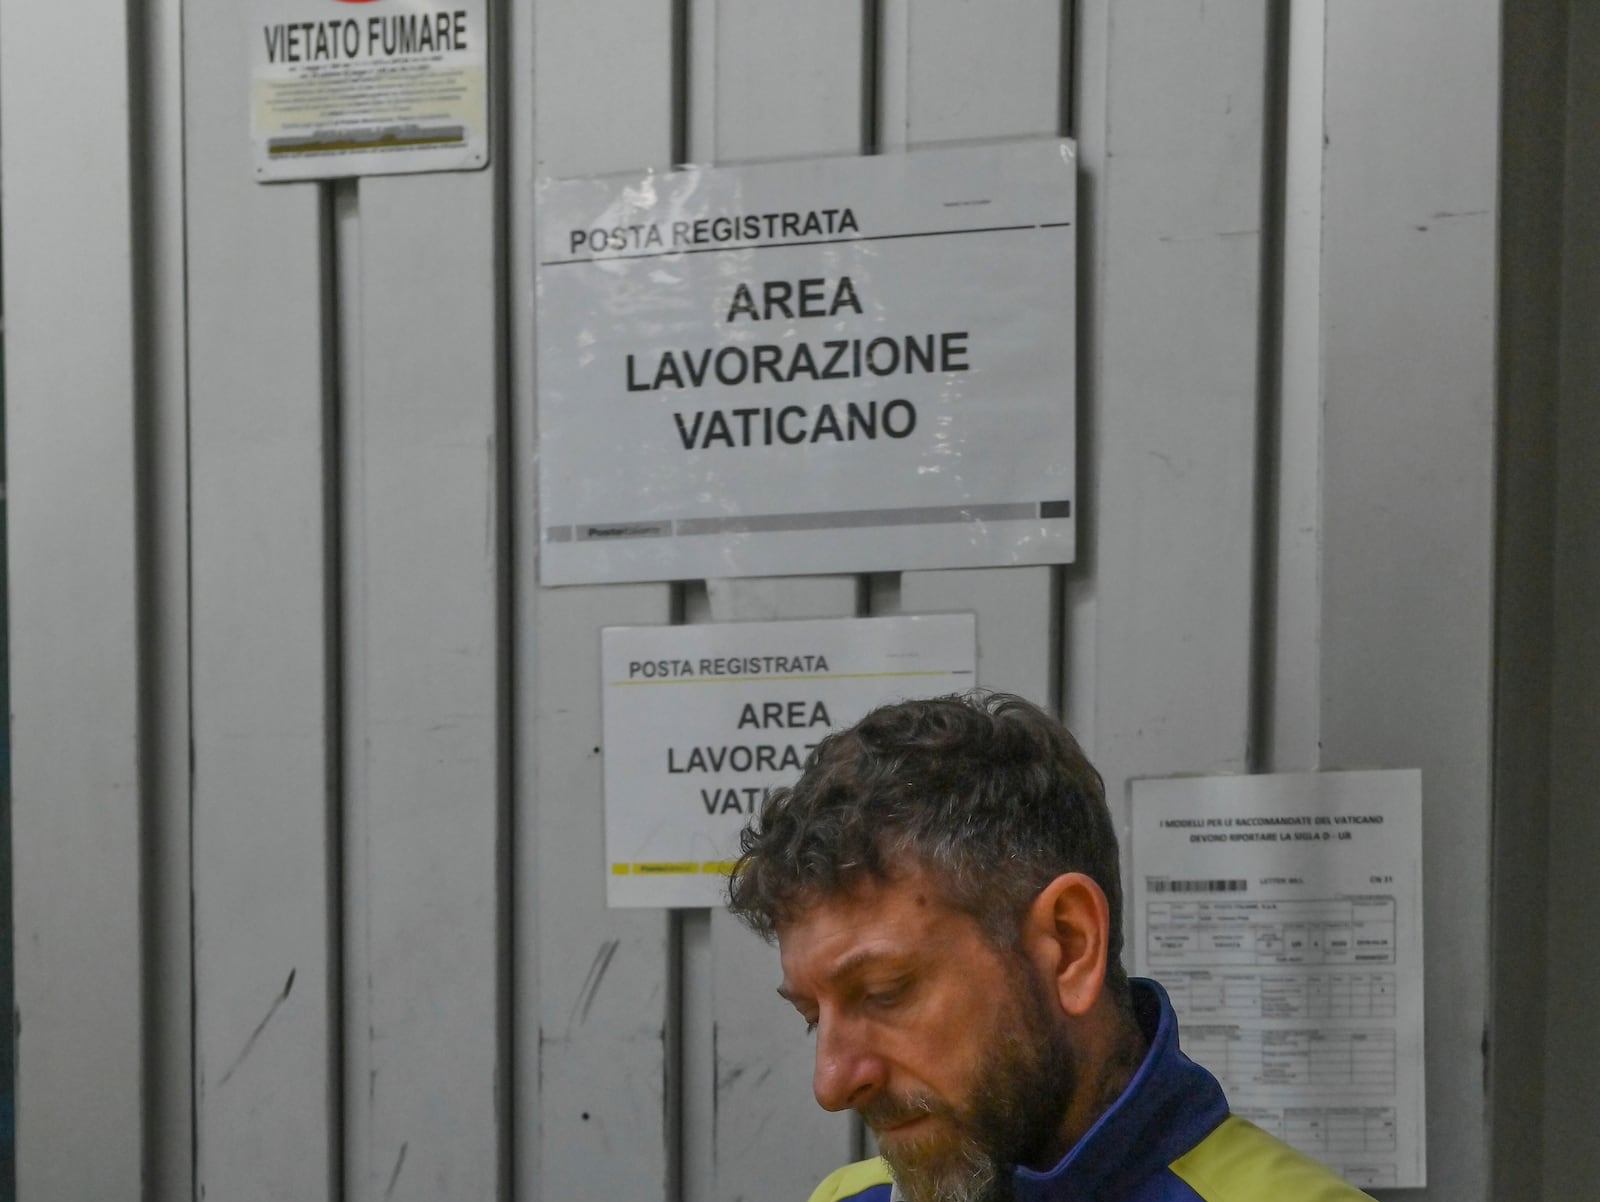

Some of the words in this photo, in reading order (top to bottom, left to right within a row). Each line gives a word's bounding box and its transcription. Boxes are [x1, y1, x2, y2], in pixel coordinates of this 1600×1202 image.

[264, 19, 359, 63] VIETATO
[368, 11, 467, 56] FUMARE
[570, 224, 663, 254] POSTA
[673, 209, 859, 245] REGISTRATA
[726, 277, 863, 323] AREA
[626, 332, 969, 392] LAVORAZIONE
[674, 399, 917, 450] VATICANO
[629, 660, 694, 679] POSTA
[700, 655, 829, 675] REGISTRATA
[738, 701, 831, 729] AREA
[1334, 815, 1384, 824] VATICANO
